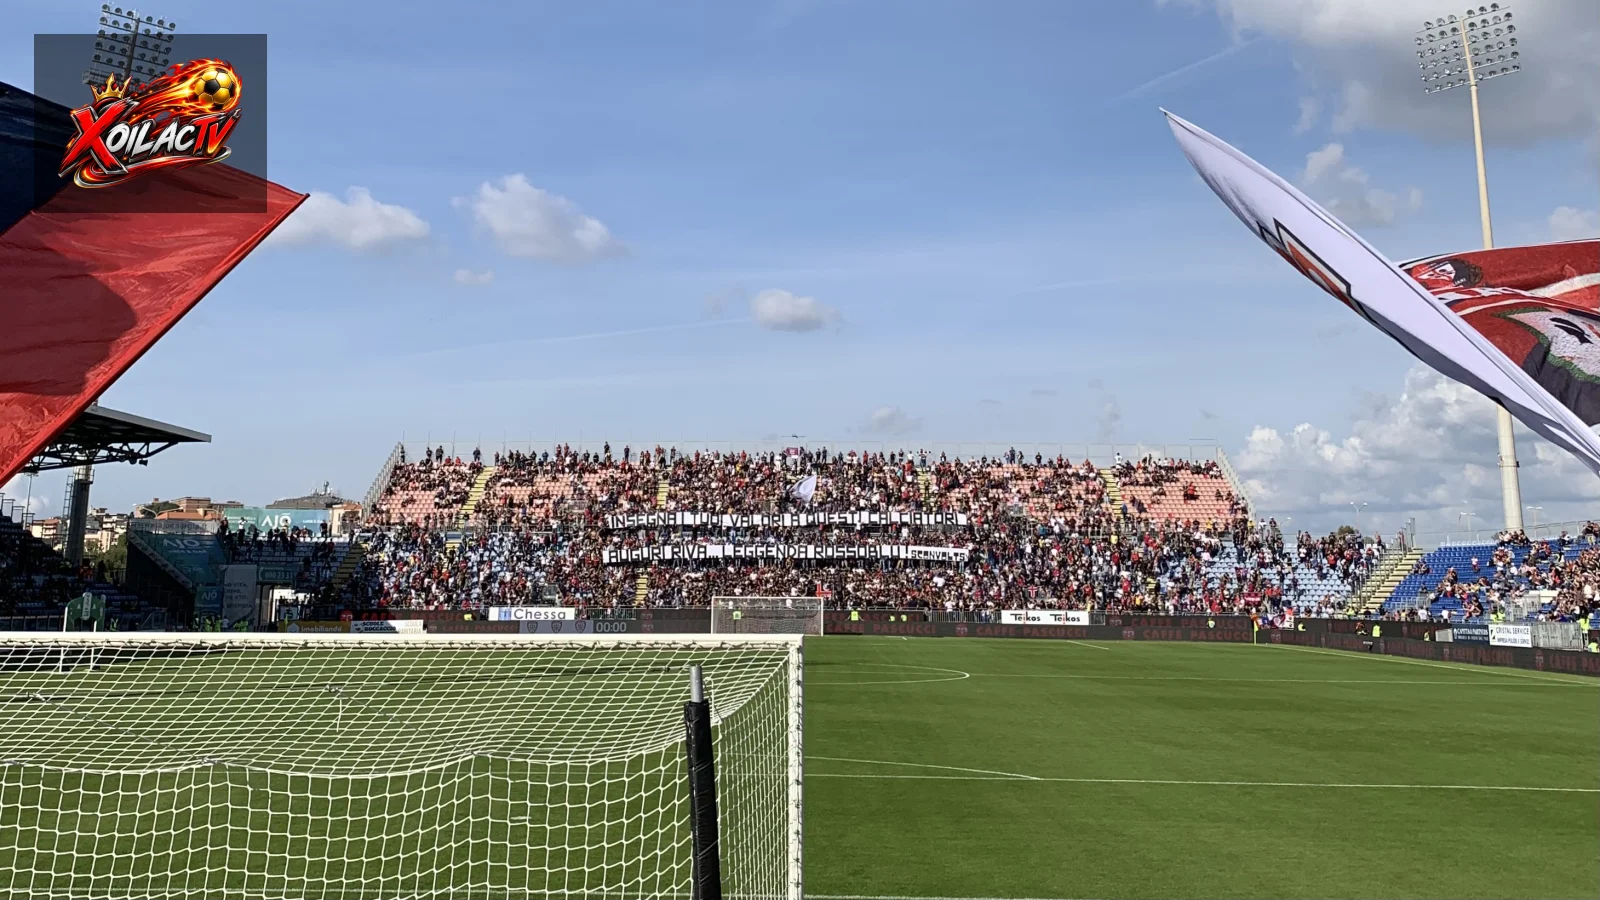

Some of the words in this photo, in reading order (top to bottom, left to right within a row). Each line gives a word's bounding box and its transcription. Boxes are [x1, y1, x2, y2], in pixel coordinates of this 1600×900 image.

[610, 512, 677, 528] INSEGNA
[690, 511, 723, 526] TUOI
[728, 514, 784, 527] VALORI
[791, 513, 800, 526] A
[806, 512, 861, 525] QUESTI
[868, 512, 959, 525] CALCIATORI
[608, 545, 664, 562] AUGURI
[722, 545, 808, 559] LEGGENDA
[514, 609, 566, 620] Chessa
[1010, 611, 1041, 624] Teikos
[1049, 611, 1081, 625] Teikos
[596, 621, 627, 632] 00:00
[1495, 627, 1512, 635] CRISTAL
[1512, 627, 1530, 636] SERVICE
